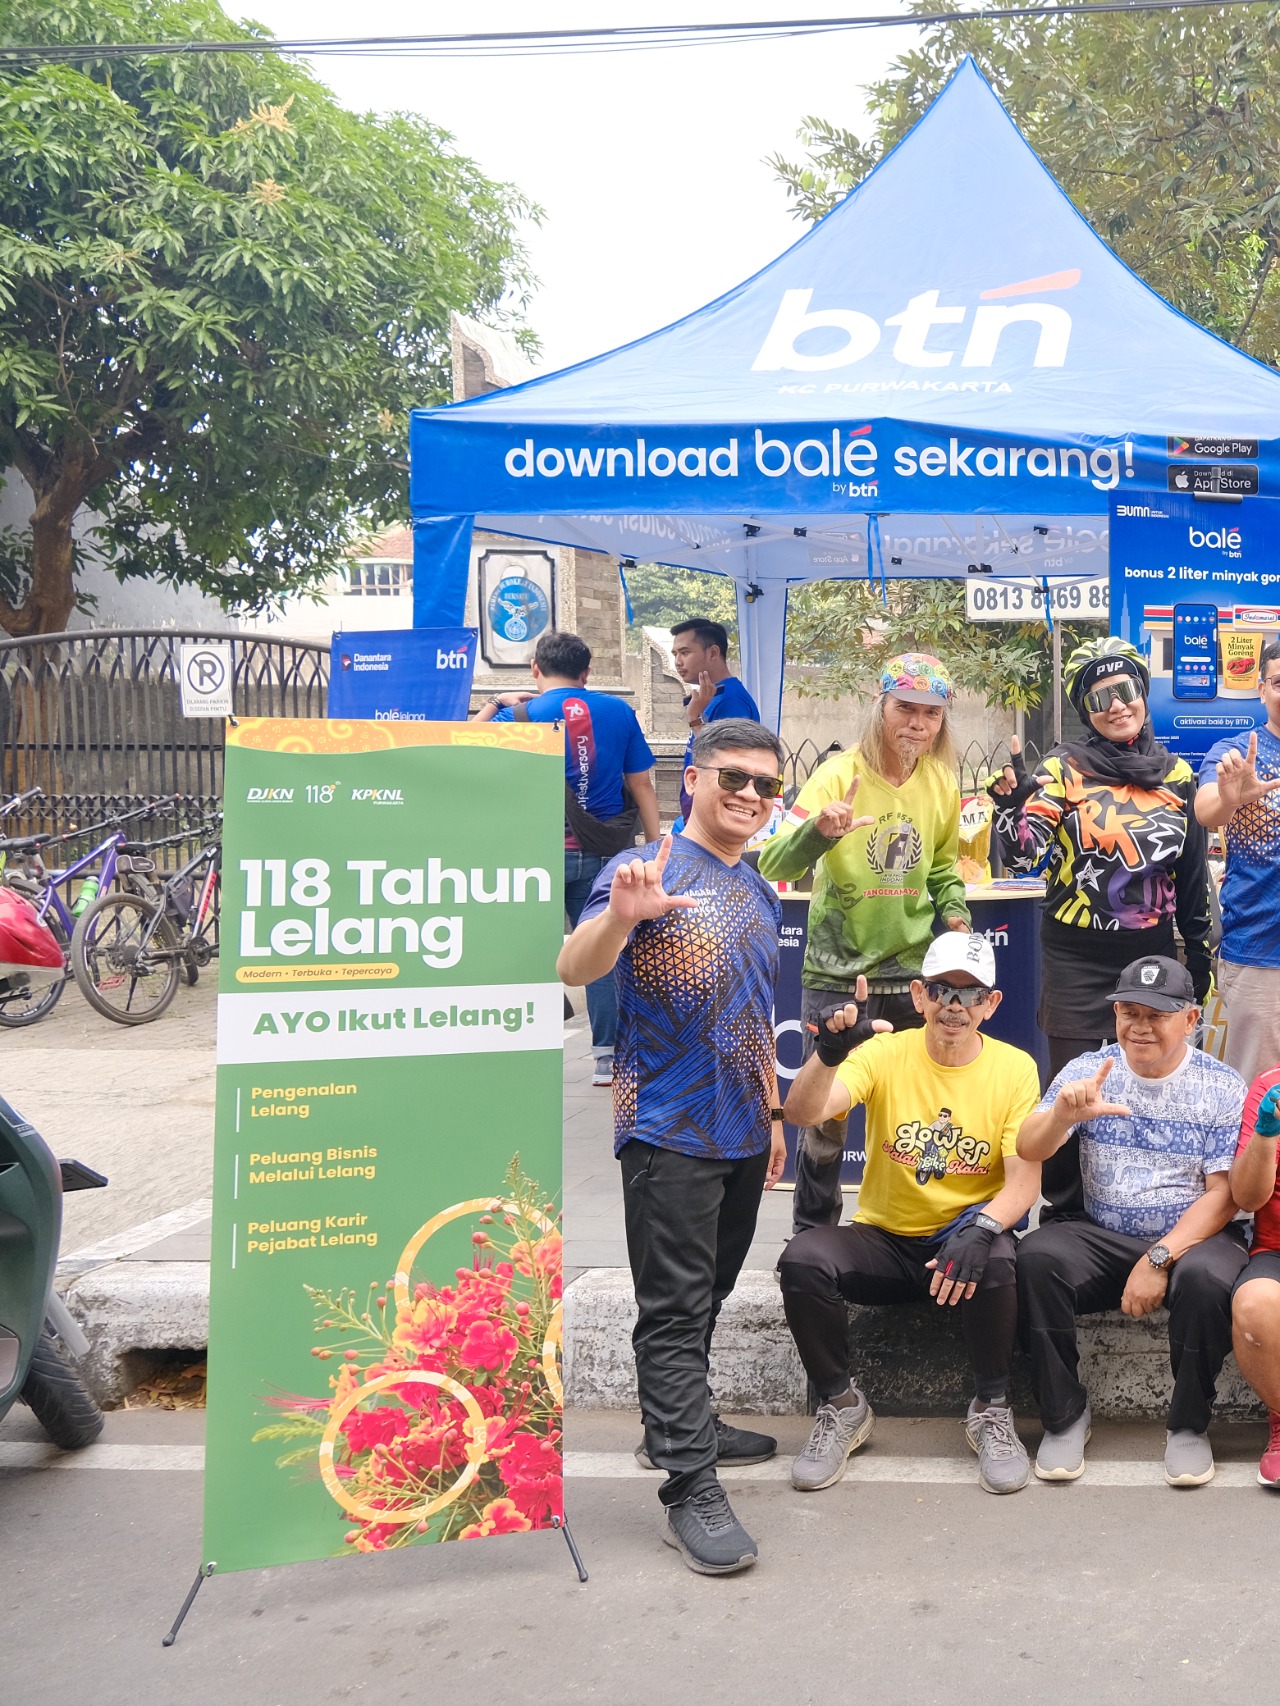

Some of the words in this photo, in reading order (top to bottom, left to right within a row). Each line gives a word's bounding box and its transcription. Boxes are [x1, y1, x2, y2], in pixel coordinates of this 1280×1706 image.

[778, 383, 816, 395] KC
[824, 380, 1014, 394] PURWAKARTA
[1194, 443, 1229, 455] Google
[1232, 443, 1252, 455] Play
[505, 438, 738, 477] download
[755, 425, 878, 476] balé
[893, 438, 1135, 490] sekarang!
[832, 482, 846, 495] by
[849, 479, 878, 497] btn
[1220, 478, 1251, 489] Store
[1189, 526, 1242, 549] balé
[1125, 567, 1164, 579] bonus
[1167, 567, 1176, 579] 2
[1179, 567, 1209, 580] liter
[1212, 570, 1258, 584] minyak
[973, 587, 1023, 610] 0813
[1243, 613, 1275, 622] Indomaret
[1227, 643, 1254, 651] Minyak
[1228, 649, 1254, 657] Goreng
[354, 653, 392, 662] Danantara
[354, 662, 389, 671] Indonesia
[1096, 661, 1124, 676] PVP
[247, 788, 294, 800] DJKN
[351, 788, 404, 801] KPKNL
[239, 858, 332, 907] 118
[346, 857, 551, 906] Tahun
[239, 907, 463, 969] Lelang
[243, 970, 282, 978] Modern
[292, 969, 332, 977] Terbuka
[342, 967, 393, 977] Tepercaya
[252, 1010, 331, 1035] AYO
[338, 1007, 406, 1032] Ikut
[413, 1001, 535, 1033] Lelang!
[251, 1082, 357, 1101] Pengenalan
[251, 1103, 310, 1119] Lelang
[250, 1149, 323, 1166] Peluang
[327, 1145, 377, 1161] Bisnis
[249, 1166, 315, 1184] Melalui
[319, 1163, 376, 1180] Lelang
[248, 1217, 321, 1235] Peluang
[325, 1213, 367, 1228] Karir
[247, 1235, 317, 1254] Pejabat
[320, 1231, 378, 1247] Lelang
